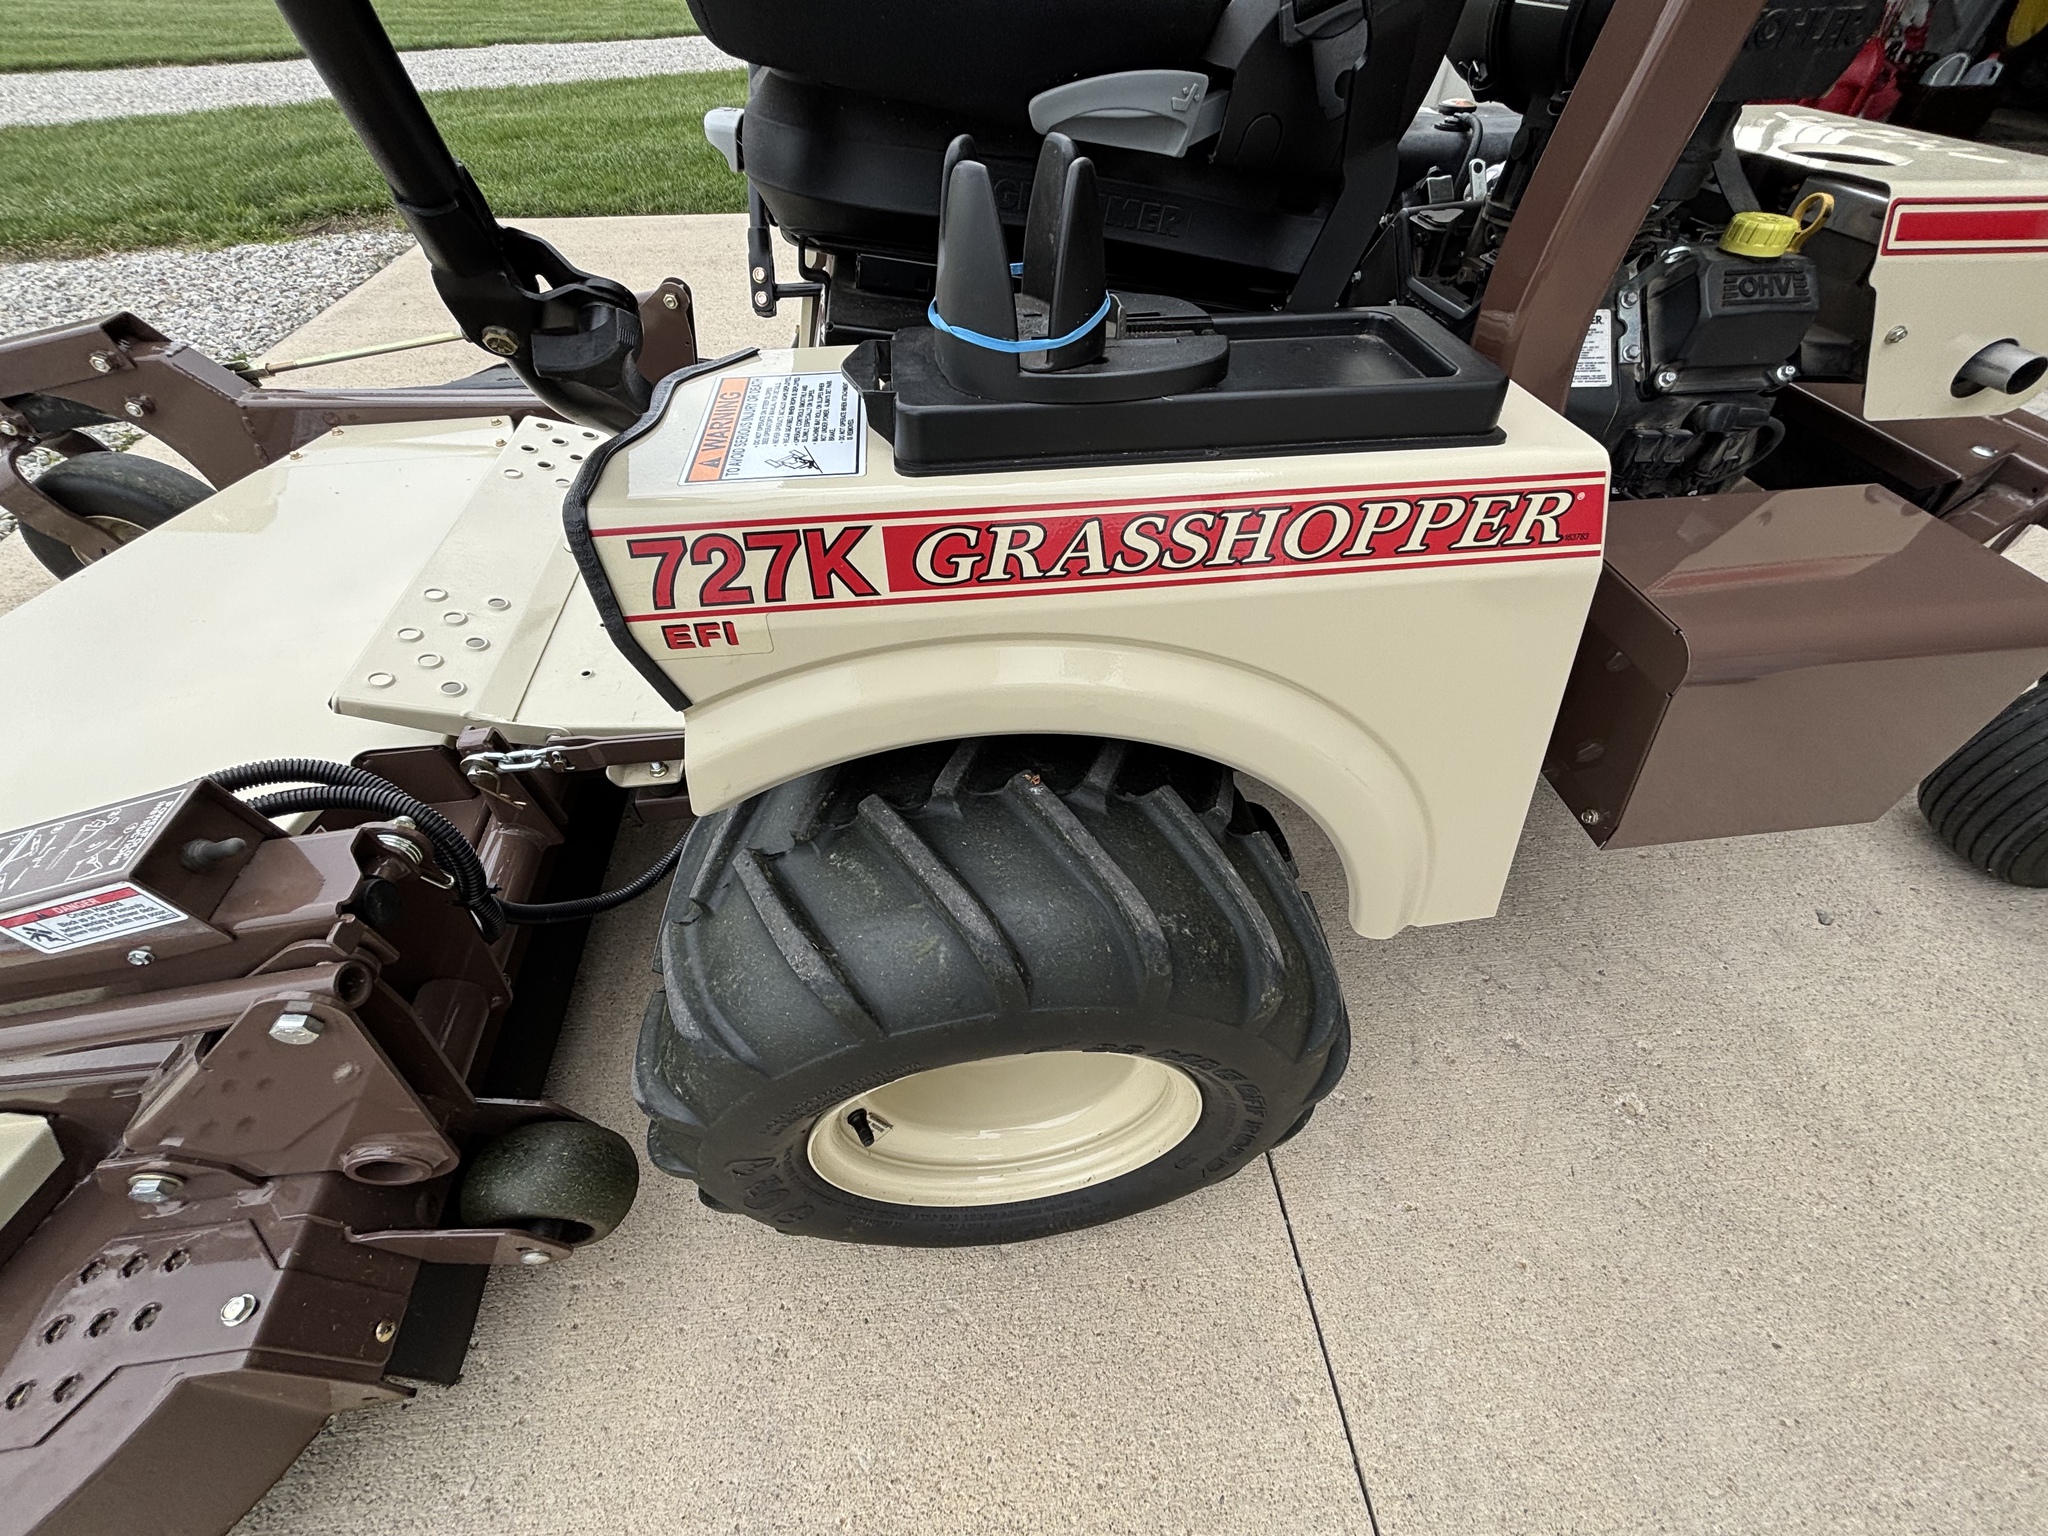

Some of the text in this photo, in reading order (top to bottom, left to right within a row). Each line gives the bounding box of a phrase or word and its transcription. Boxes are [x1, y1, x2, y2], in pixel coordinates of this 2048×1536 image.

[1738, 274, 1791, 298] OHV
[749, 379, 762, 393] DEATH
[742, 403, 756, 421] INJURY
[796, 409, 804, 426] CONTROLS
[702, 393, 741, 451] WARNING
[757, 416, 765, 431] OPERATE
[734, 423, 752, 446] SERIOUS
[729, 449, 745, 466] AVOID
[725, 468, 740, 476] TO
[626, 489, 1578, 612] 727K GRASSHOPPER
[660, 620, 741, 651] EFI
[52, 898, 100, 913] DANGER
[66, 902, 123, 918] Crush Hazard
